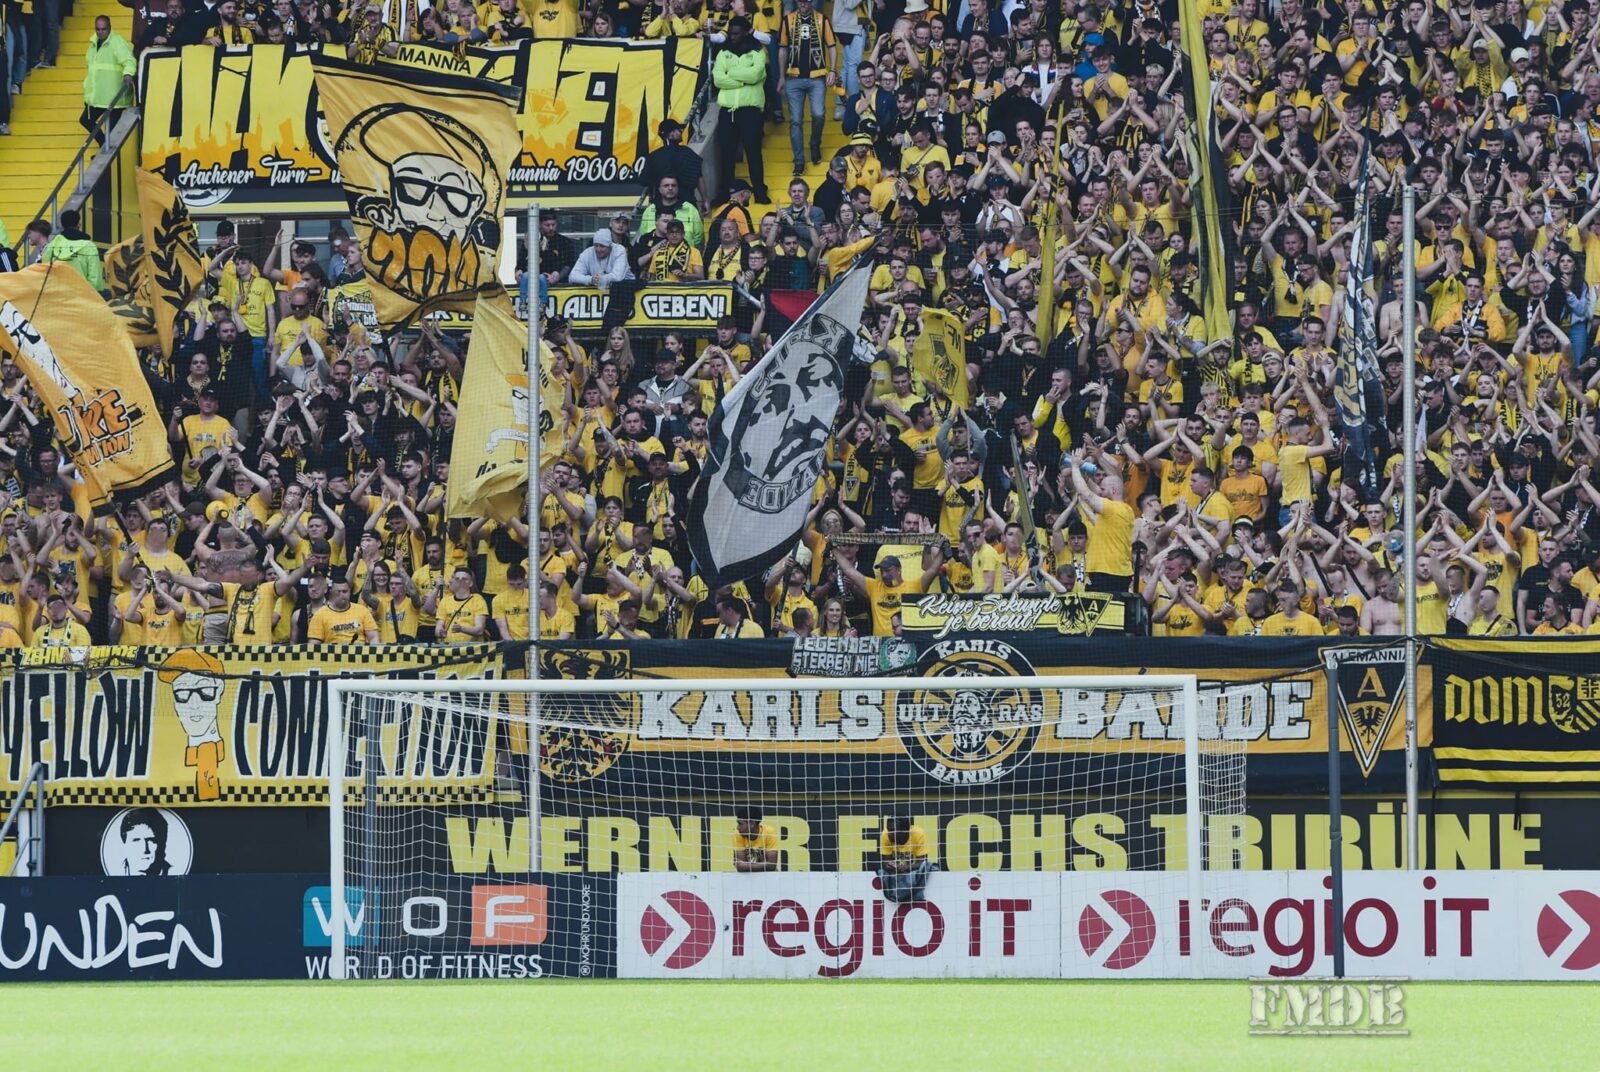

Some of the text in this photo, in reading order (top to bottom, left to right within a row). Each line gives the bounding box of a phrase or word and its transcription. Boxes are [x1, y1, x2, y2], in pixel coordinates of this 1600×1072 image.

[178, 163, 254, 185] Aachener
[260, 157, 320, 186] Turn-
[567, 157, 616, 181] 1900
[643, 294, 725, 319] GEBEN!
[917, 589, 1061, 616] Keine Sekunde
[932, 612, 963, 639] je
[795, 637, 880, 653] LEGENDEN
[934, 639, 1011, 660] KARLS
[793, 651, 880, 672] STERBEN NIE!
[1357, 667, 1386, 698] A
[1, 671, 154, 781] YELLOW
[638, 690, 885, 741] KARLS
[931, 763, 1005, 784] BANDE
[1150, 802, 1544, 871] TRIBÜNE
[0, 894, 223, 970] UNDEN
[733, 876, 946, 978] regio
[1179, 875, 1399, 977] regio
[401, 956, 432, 979] OF
[441, 954, 543, 979] FITNESS
